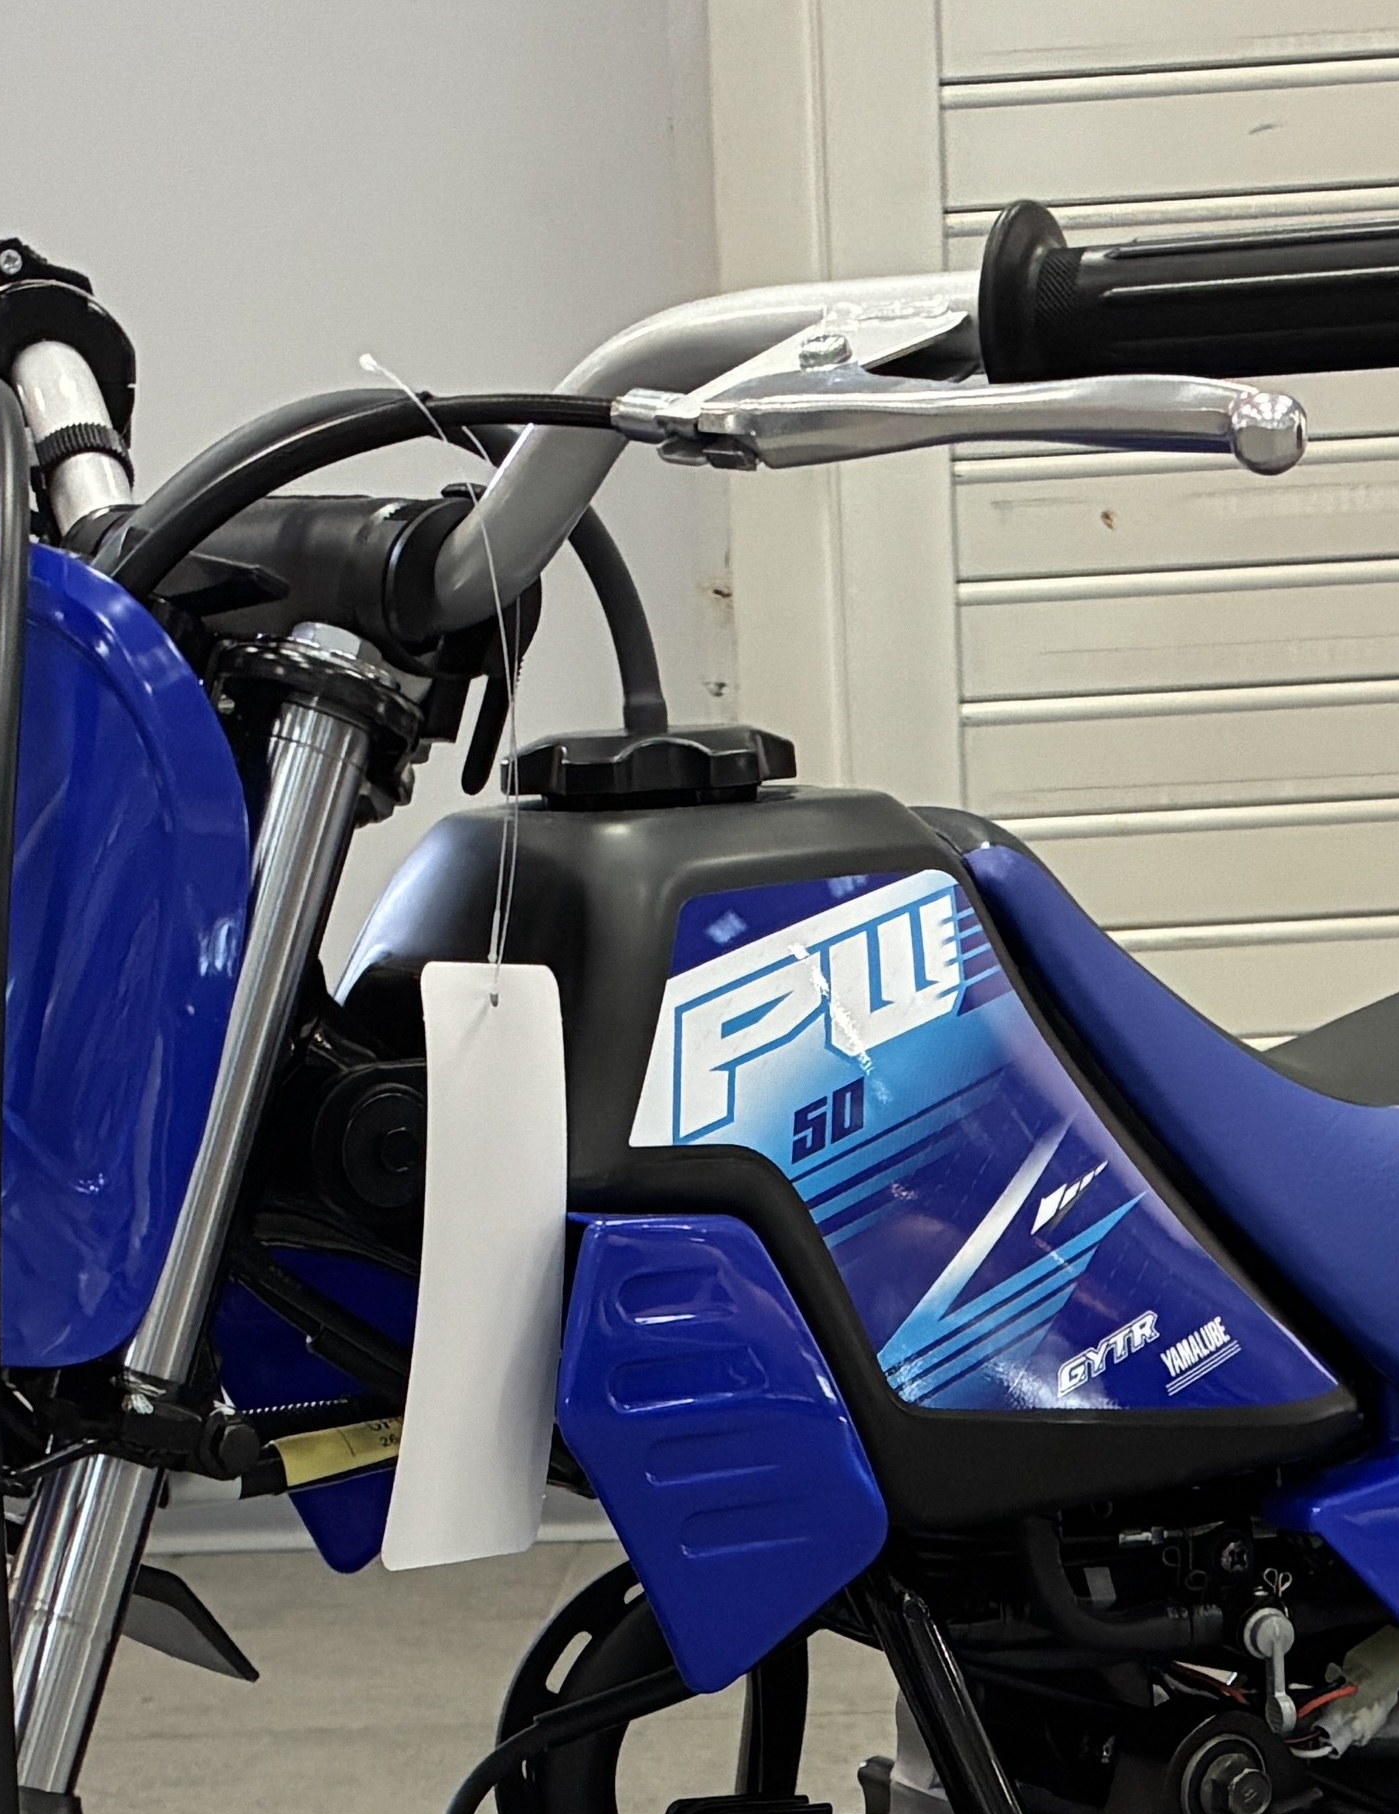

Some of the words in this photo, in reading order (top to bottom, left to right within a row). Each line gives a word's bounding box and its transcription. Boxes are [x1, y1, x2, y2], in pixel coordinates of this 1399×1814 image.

[672, 886, 964, 1145] PW
[791, 1078, 865, 1165] 50
[1057, 1310, 1160, 1398] GYTR
[1160, 1315, 1231, 1378] YAMALUBE
